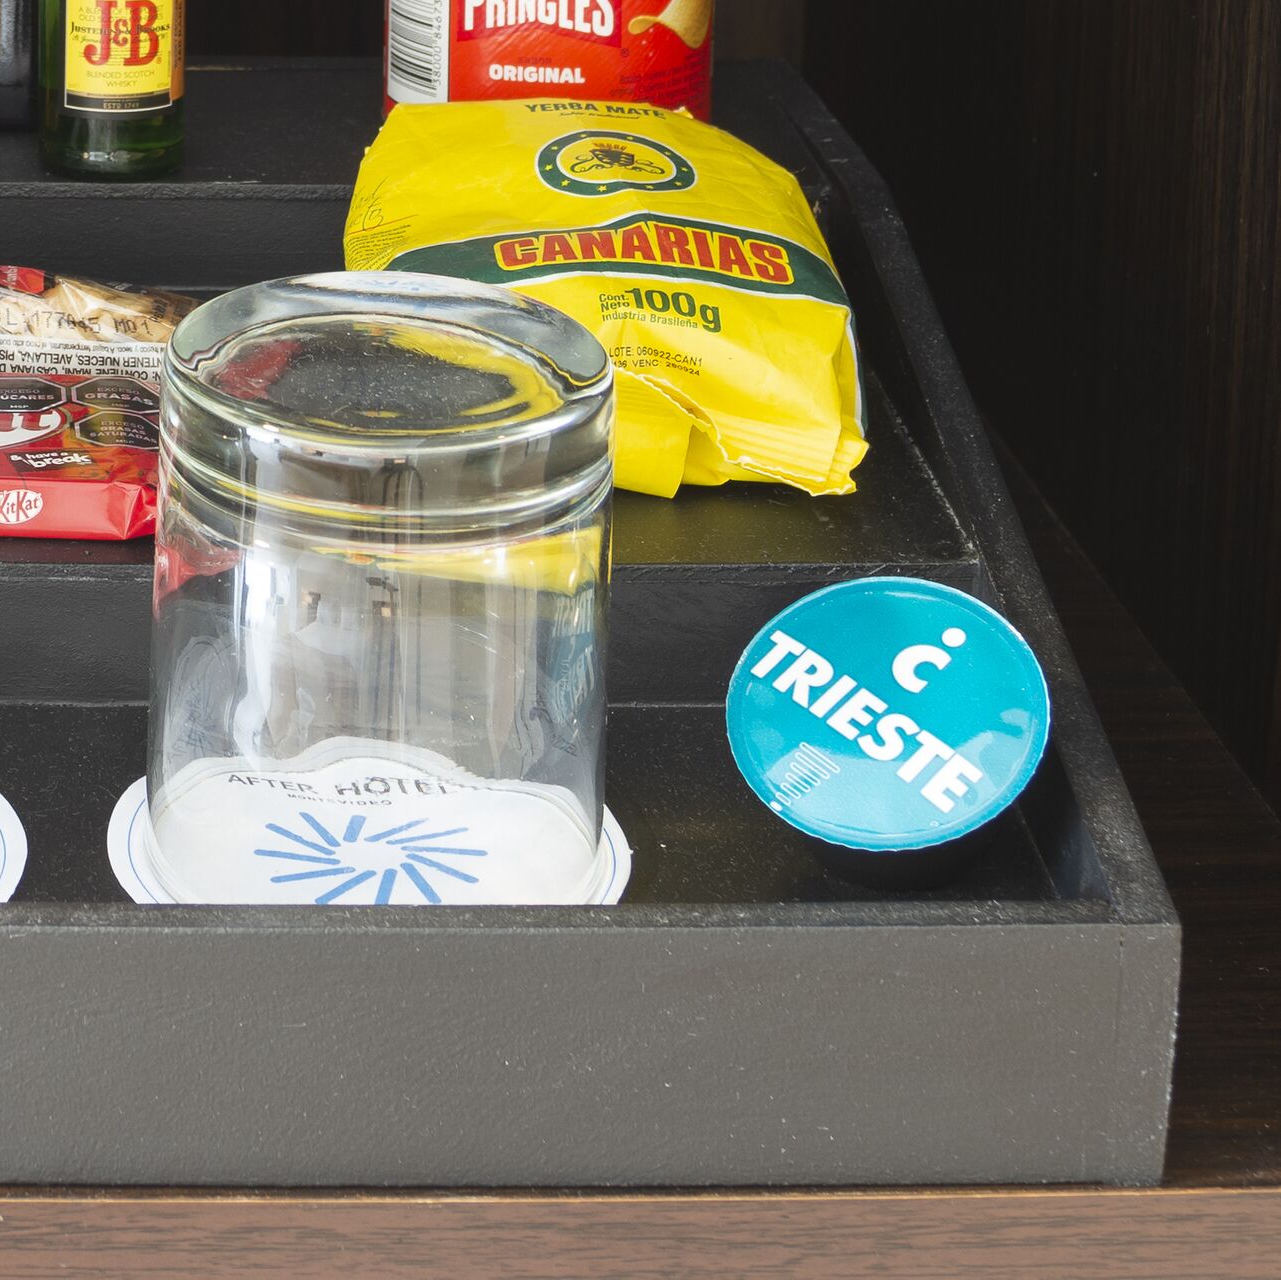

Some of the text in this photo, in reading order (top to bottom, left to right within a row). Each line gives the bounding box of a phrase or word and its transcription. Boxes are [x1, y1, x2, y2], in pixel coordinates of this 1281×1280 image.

[83, 0, 159, 67] J&B
[86, 69, 155, 79] BLENDED SCOTCH
[488, 63, 586, 85] ORIGINAL
[105, 80, 136, 88] WHISKY
[525, 102, 667, 120] YERBA MATE
[497, 223, 792, 284] CANARIAS
[599, 293, 630, 303] Cont.
[601, 301, 630, 312] Neto
[602, 310, 698, 329] Industria Brasileña
[75, 354, 121, 368] NUECES,
[608, 346, 702, 367] LOTE: 060922-CAN1
[84, 392, 154, 406] GRASAS
[26, 452, 59, 460] have
[27, 453, 92, 469] break
[750, 630, 983, 814] TRIESTE
[228, 774, 318, 795] AFTER
